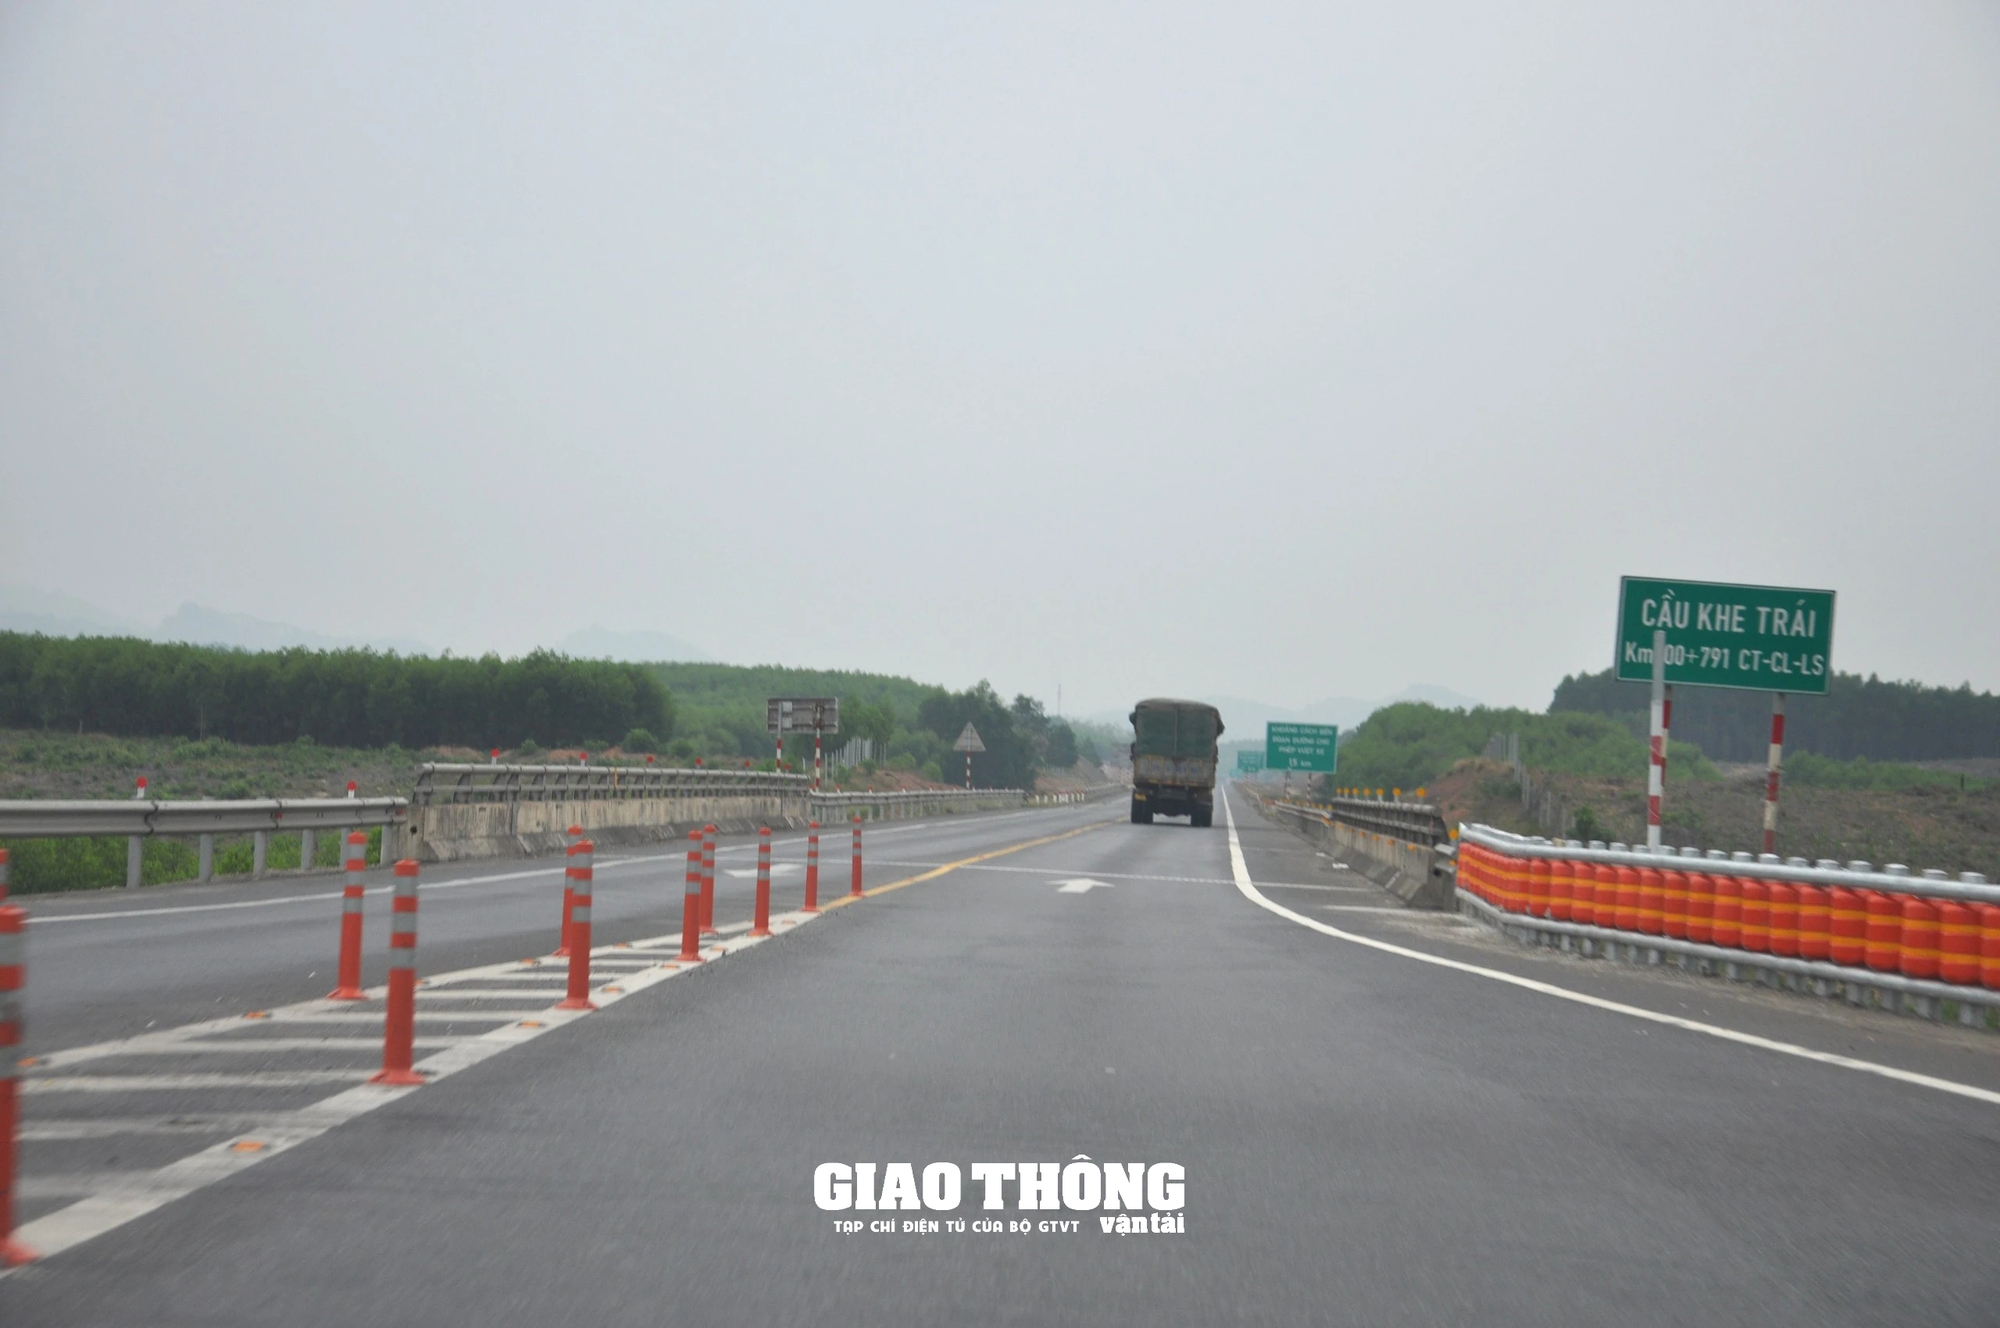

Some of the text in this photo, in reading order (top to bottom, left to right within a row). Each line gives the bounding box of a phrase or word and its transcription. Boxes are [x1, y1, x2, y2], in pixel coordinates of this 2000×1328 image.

[1641, 589, 1817, 638] CẦU KHE TRÁI
[1624, 641, 1825, 676] Km00+791 CT-CL-LS
